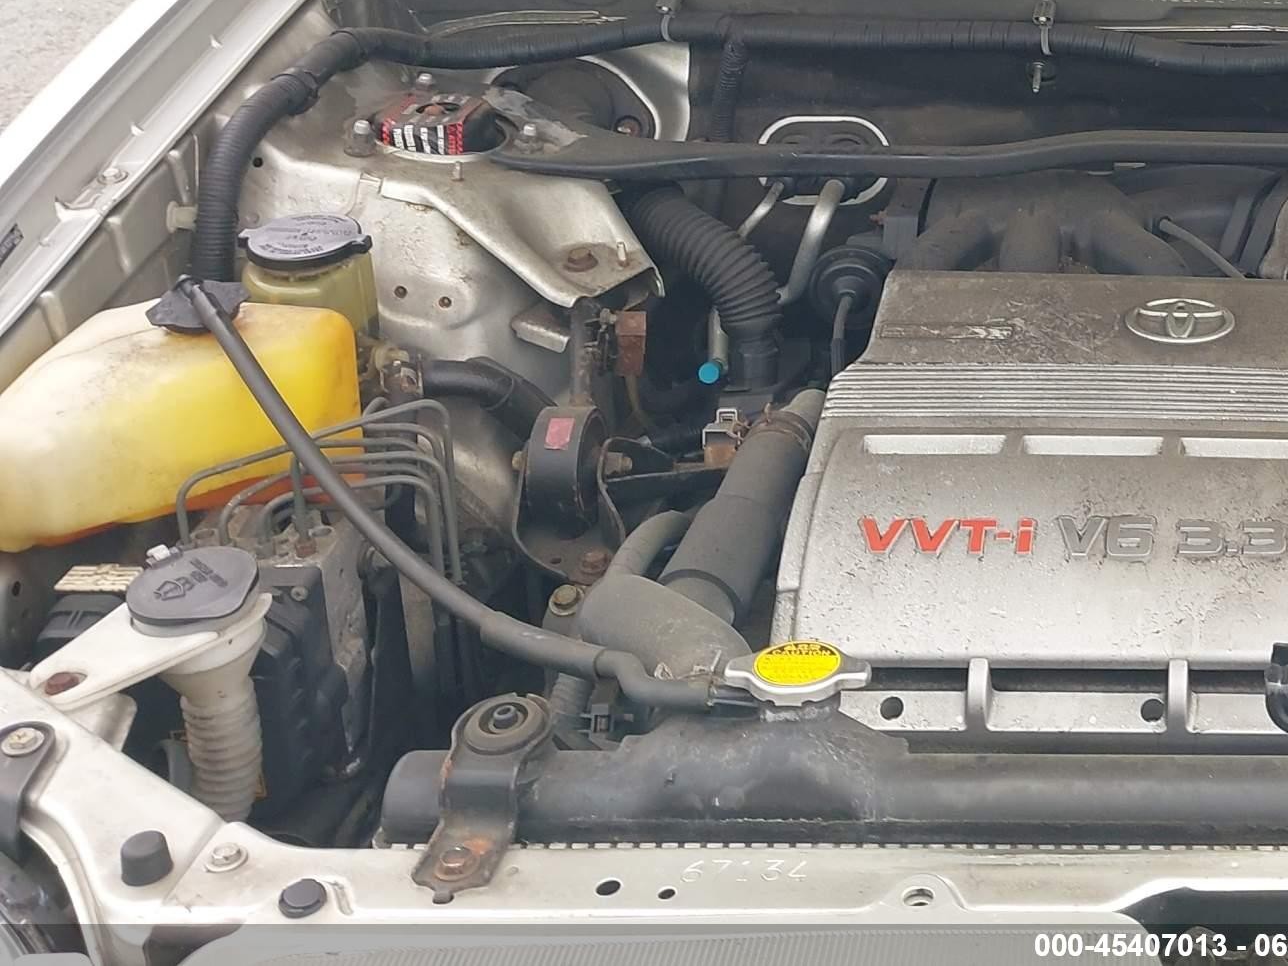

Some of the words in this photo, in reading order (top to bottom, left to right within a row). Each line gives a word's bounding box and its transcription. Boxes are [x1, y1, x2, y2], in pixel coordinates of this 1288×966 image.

[860, 516, 1038, 555] VVT-i
[1056, 515, 1156, 558] V6
[1176, 518, 1288, 557] 3.3
